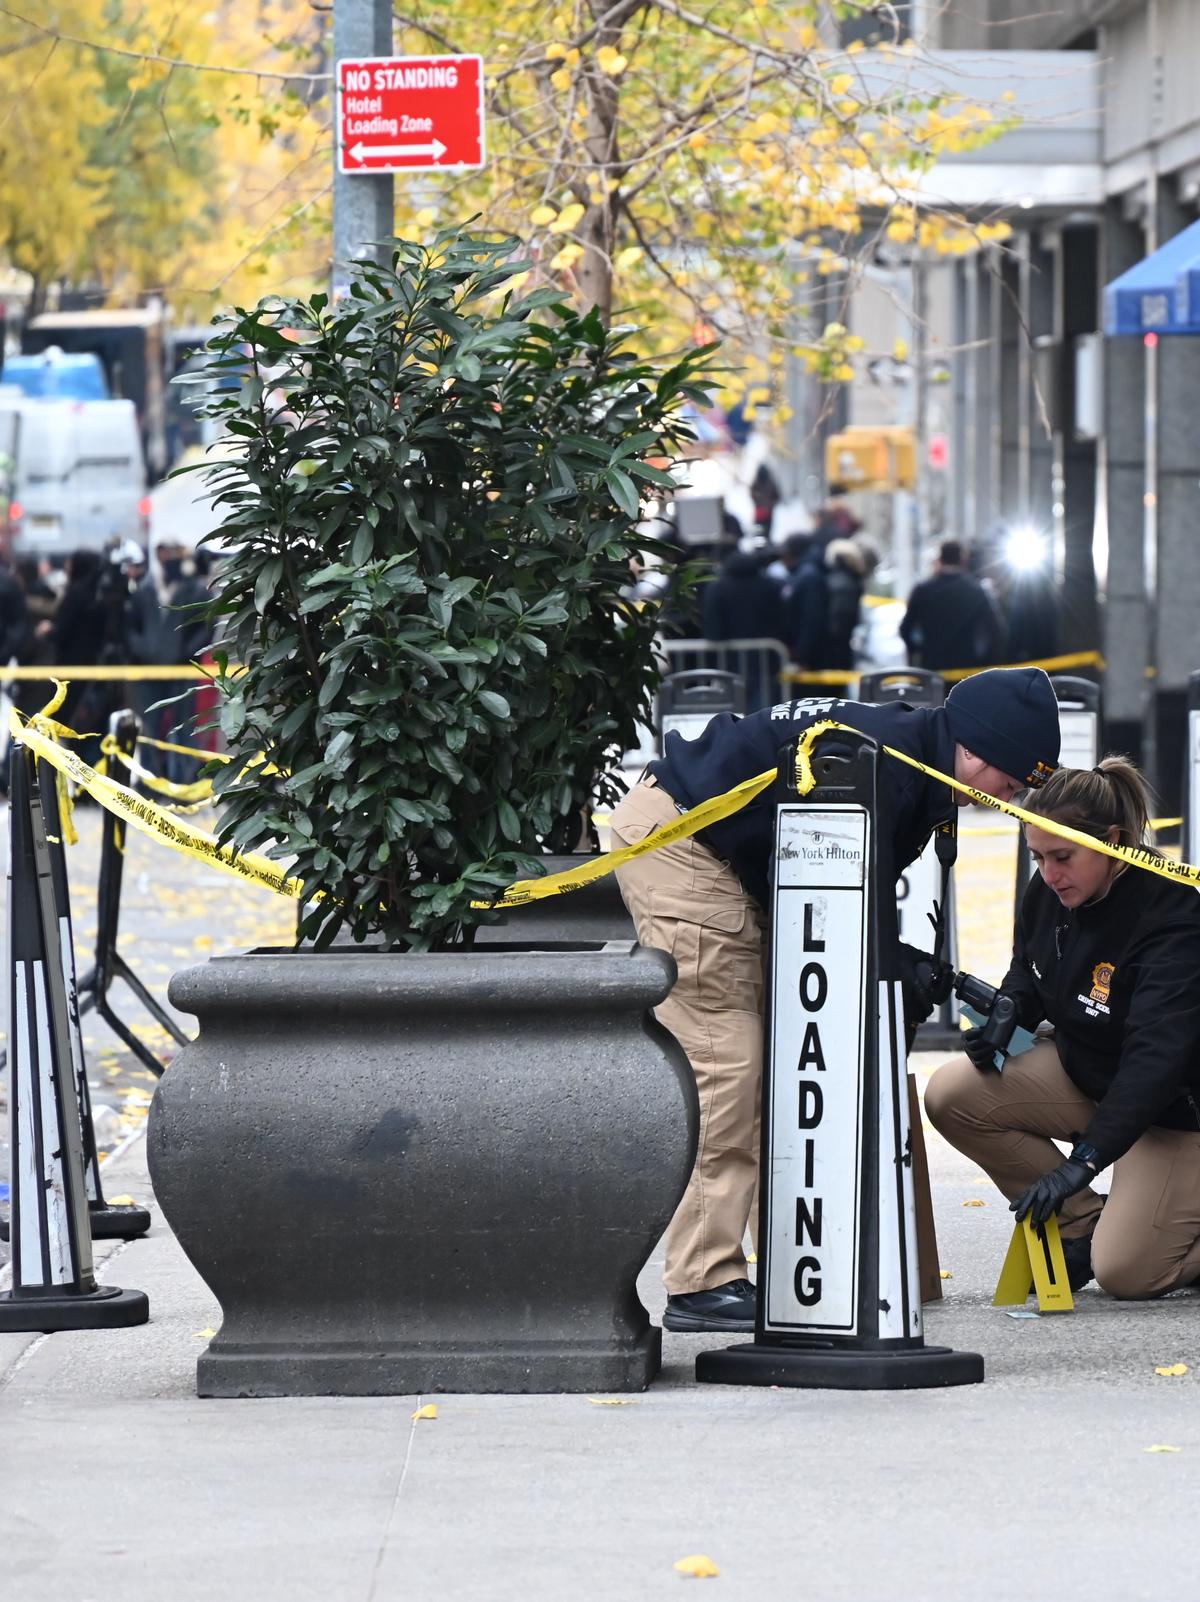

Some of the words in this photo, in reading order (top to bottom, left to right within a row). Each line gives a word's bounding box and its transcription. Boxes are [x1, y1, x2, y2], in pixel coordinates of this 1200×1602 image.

[346, 70, 370, 92] NO
[374, 67, 458, 90] STANDING
[346, 96, 382, 114] Hotel
[346, 116, 398, 137] Loading
[400, 115, 433, 133] Zone
[781, 847, 799, 860] New
[802, 847, 824, 860] York
[826, 847, 861, 860] Hilton
[1095, 1002, 1110, 1015] SCEN
[793, 903, 828, 1307] LOADING
[1036, 1221, 1057, 1285] 1
